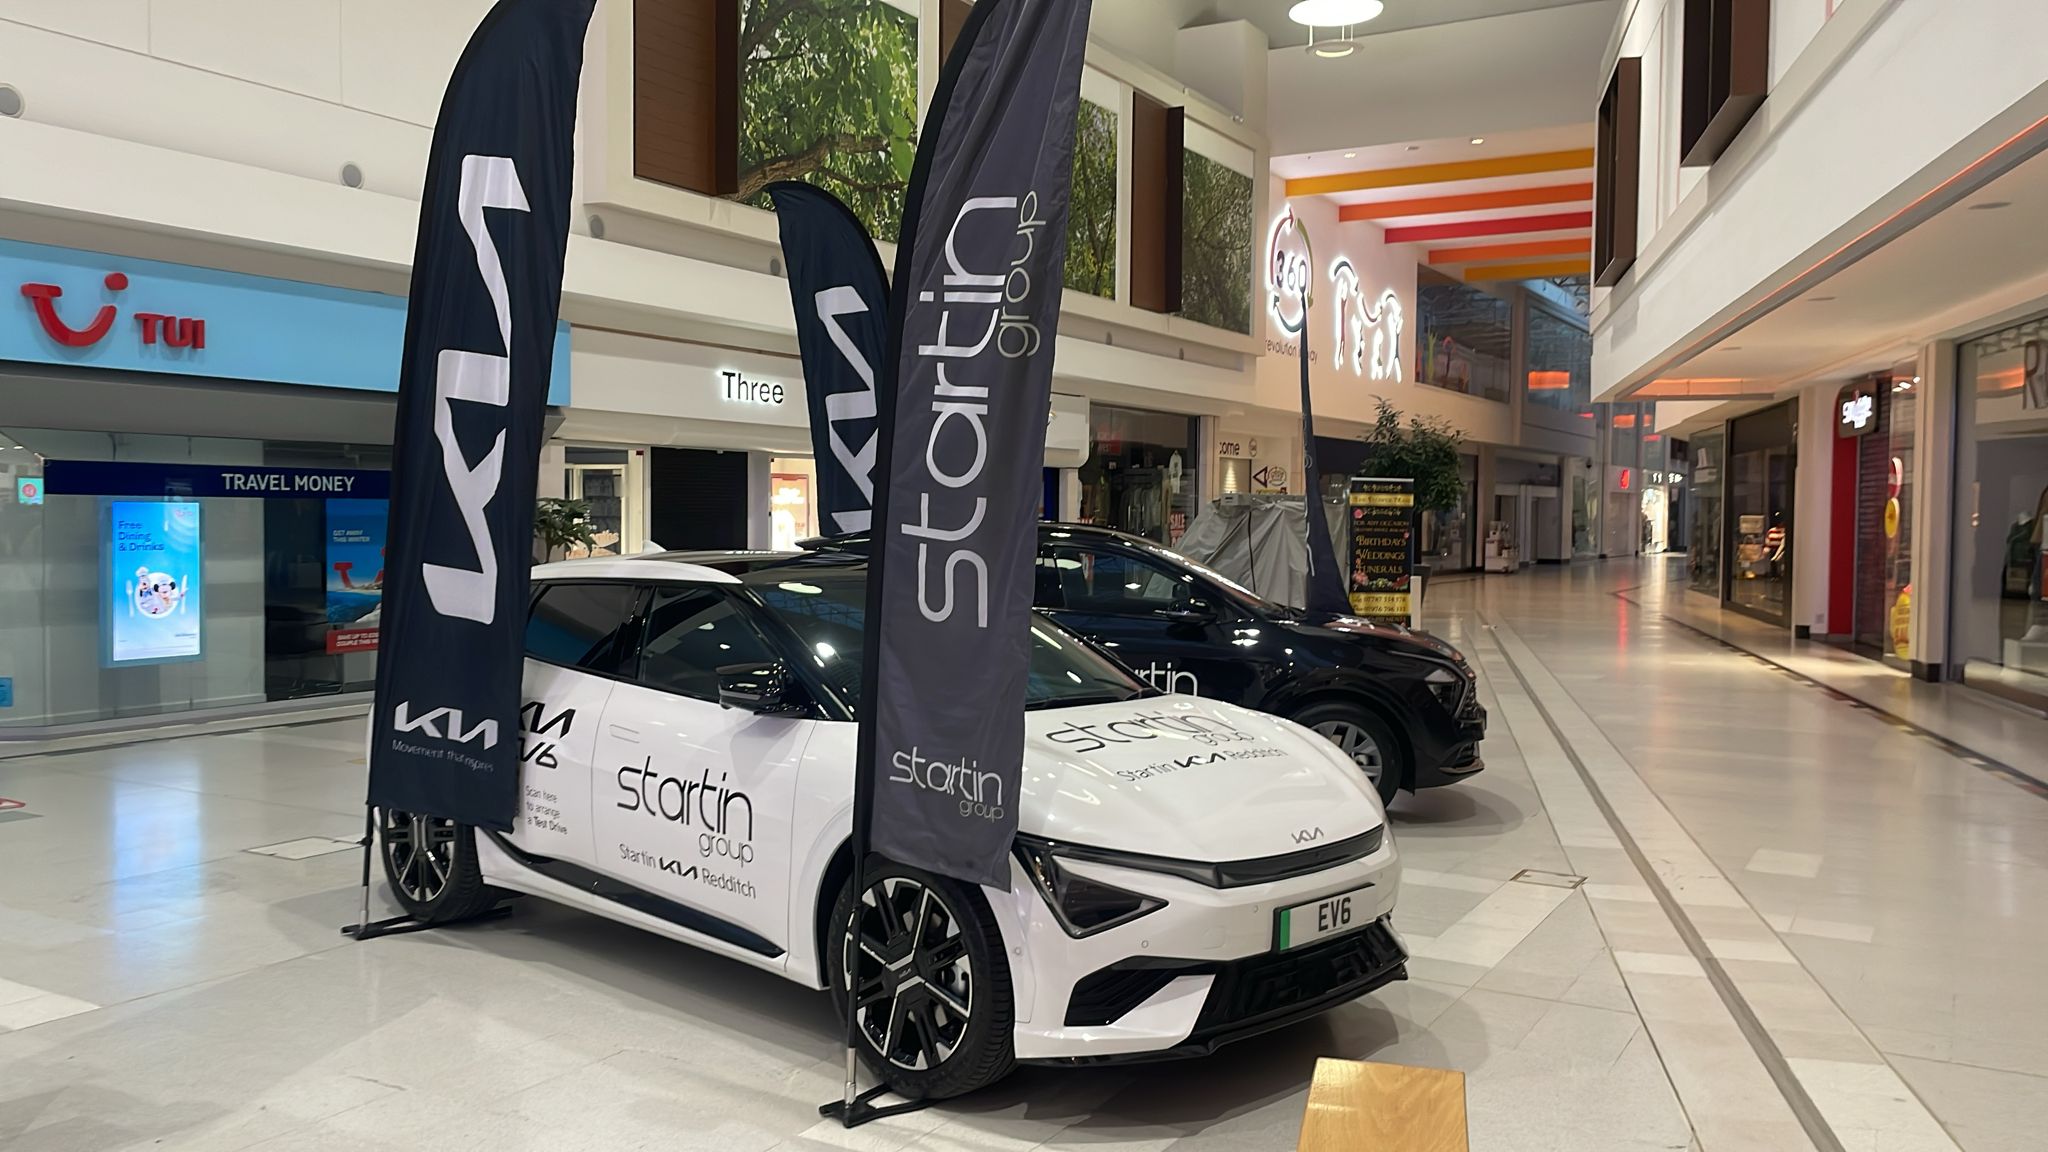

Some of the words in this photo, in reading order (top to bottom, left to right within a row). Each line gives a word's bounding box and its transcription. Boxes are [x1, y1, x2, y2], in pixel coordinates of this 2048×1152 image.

[997, 190, 1046, 358] group
[1276, 250, 1307, 293] 360
[134, 313, 205, 349] TUI
[722, 371, 784, 404] Three
[901, 196, 1017, 628] startin
[221, 473, 290, 491] TRAVEL
[294, 475, 355, 492] MONEY
[118, 531, 152, 543] Dining
[129, 542, 165, 552] Drinks
[392, 739, 444, 759] Movement
[1046, 711, 1237, 753] startin
[518, 737, 558, 769] V6
[889, 746, 1002, 806] startin
[1116, 762, 1178, 782] Startin
[617, 755, 753, 841] startin
[959, 800, 1004, 823] group
[698, 833, 754, 868] group
[619, 843, 657, 868] Startin
[702, 867, 756, 899] Redditch
[1318, 897, 1352, 932] EV6
